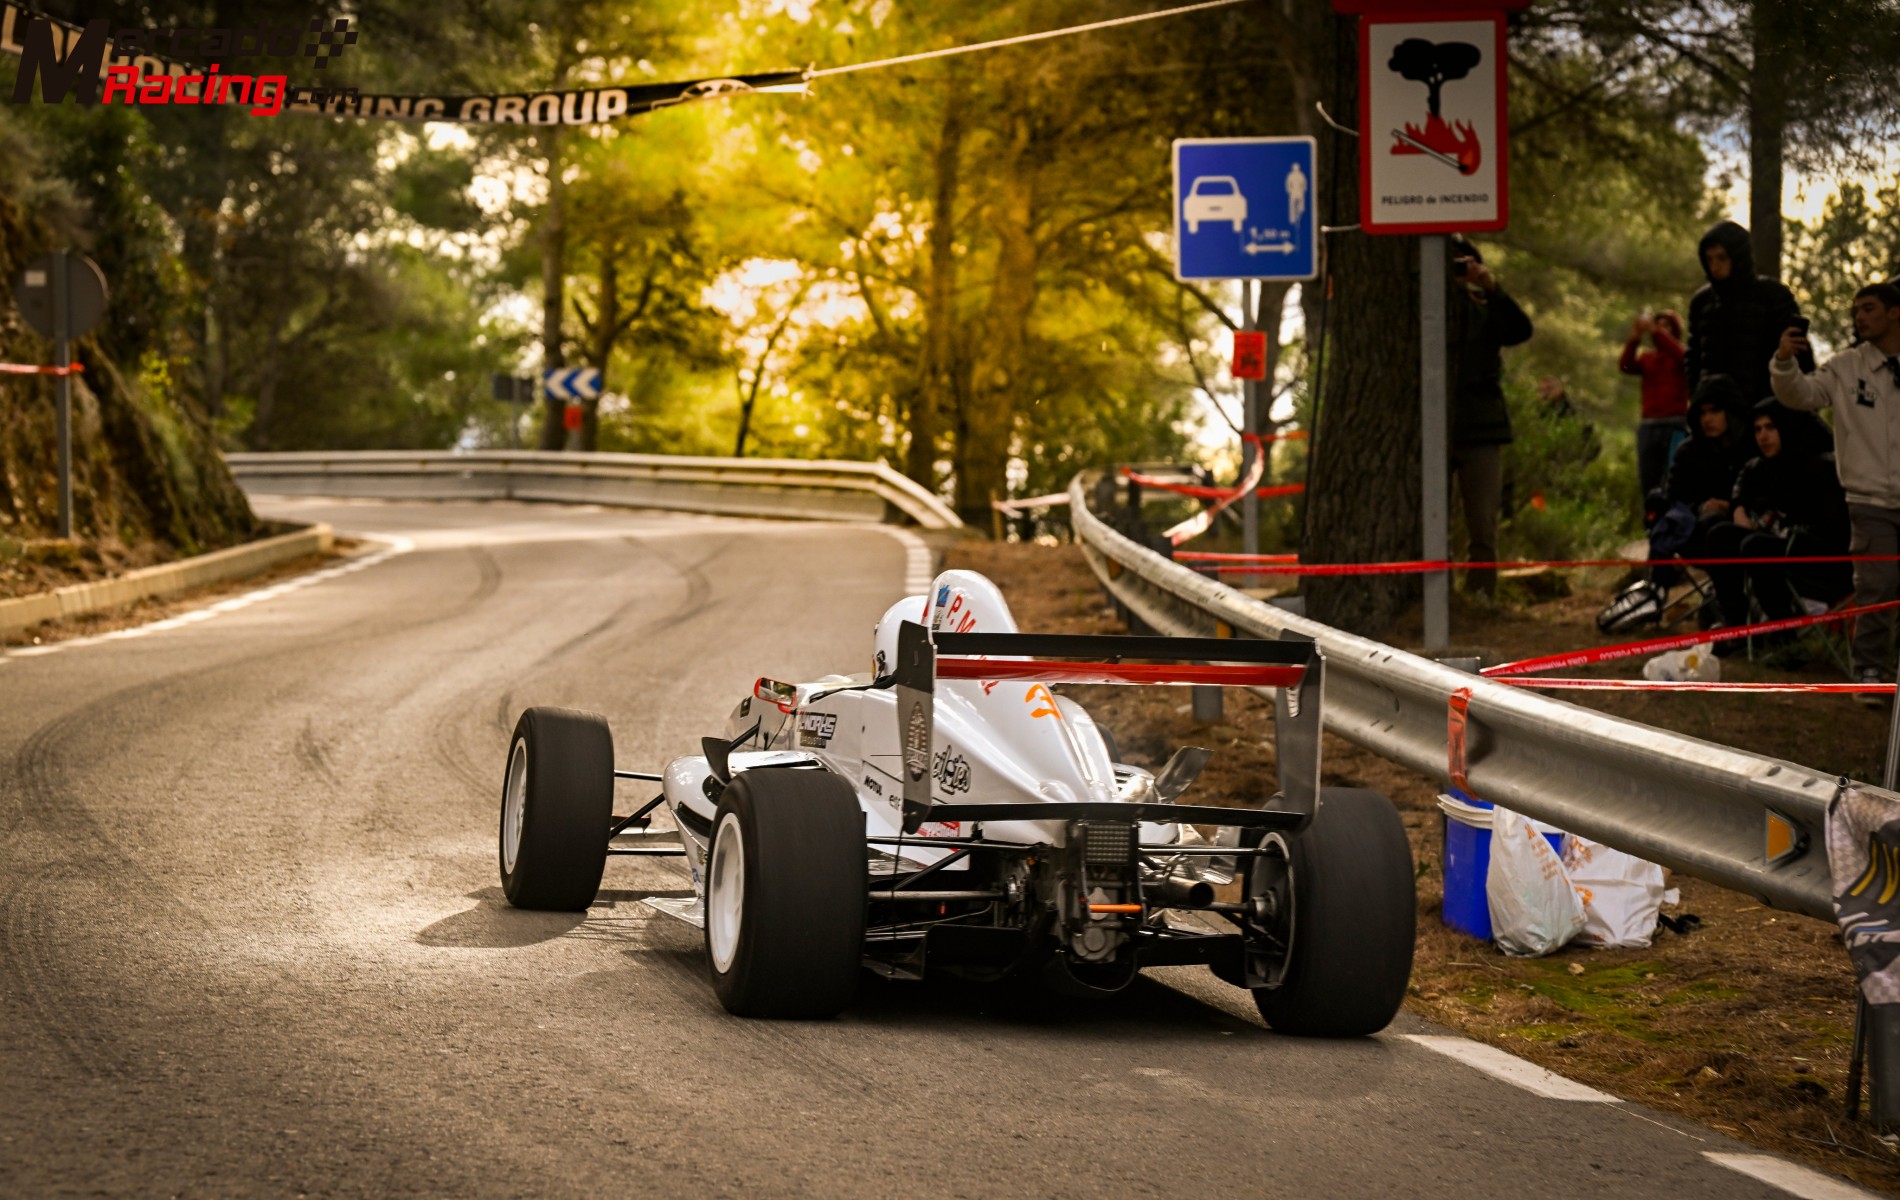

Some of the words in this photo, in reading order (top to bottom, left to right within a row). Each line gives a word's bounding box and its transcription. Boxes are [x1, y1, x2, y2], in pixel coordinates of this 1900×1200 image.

[460, 89, 628, 125] GROUP
[1381, 195, 1423, 205] PELIGRO
[1440, 193, 1489, 203] INCENDIO
[864, 775, 882, 796] MOTUL
